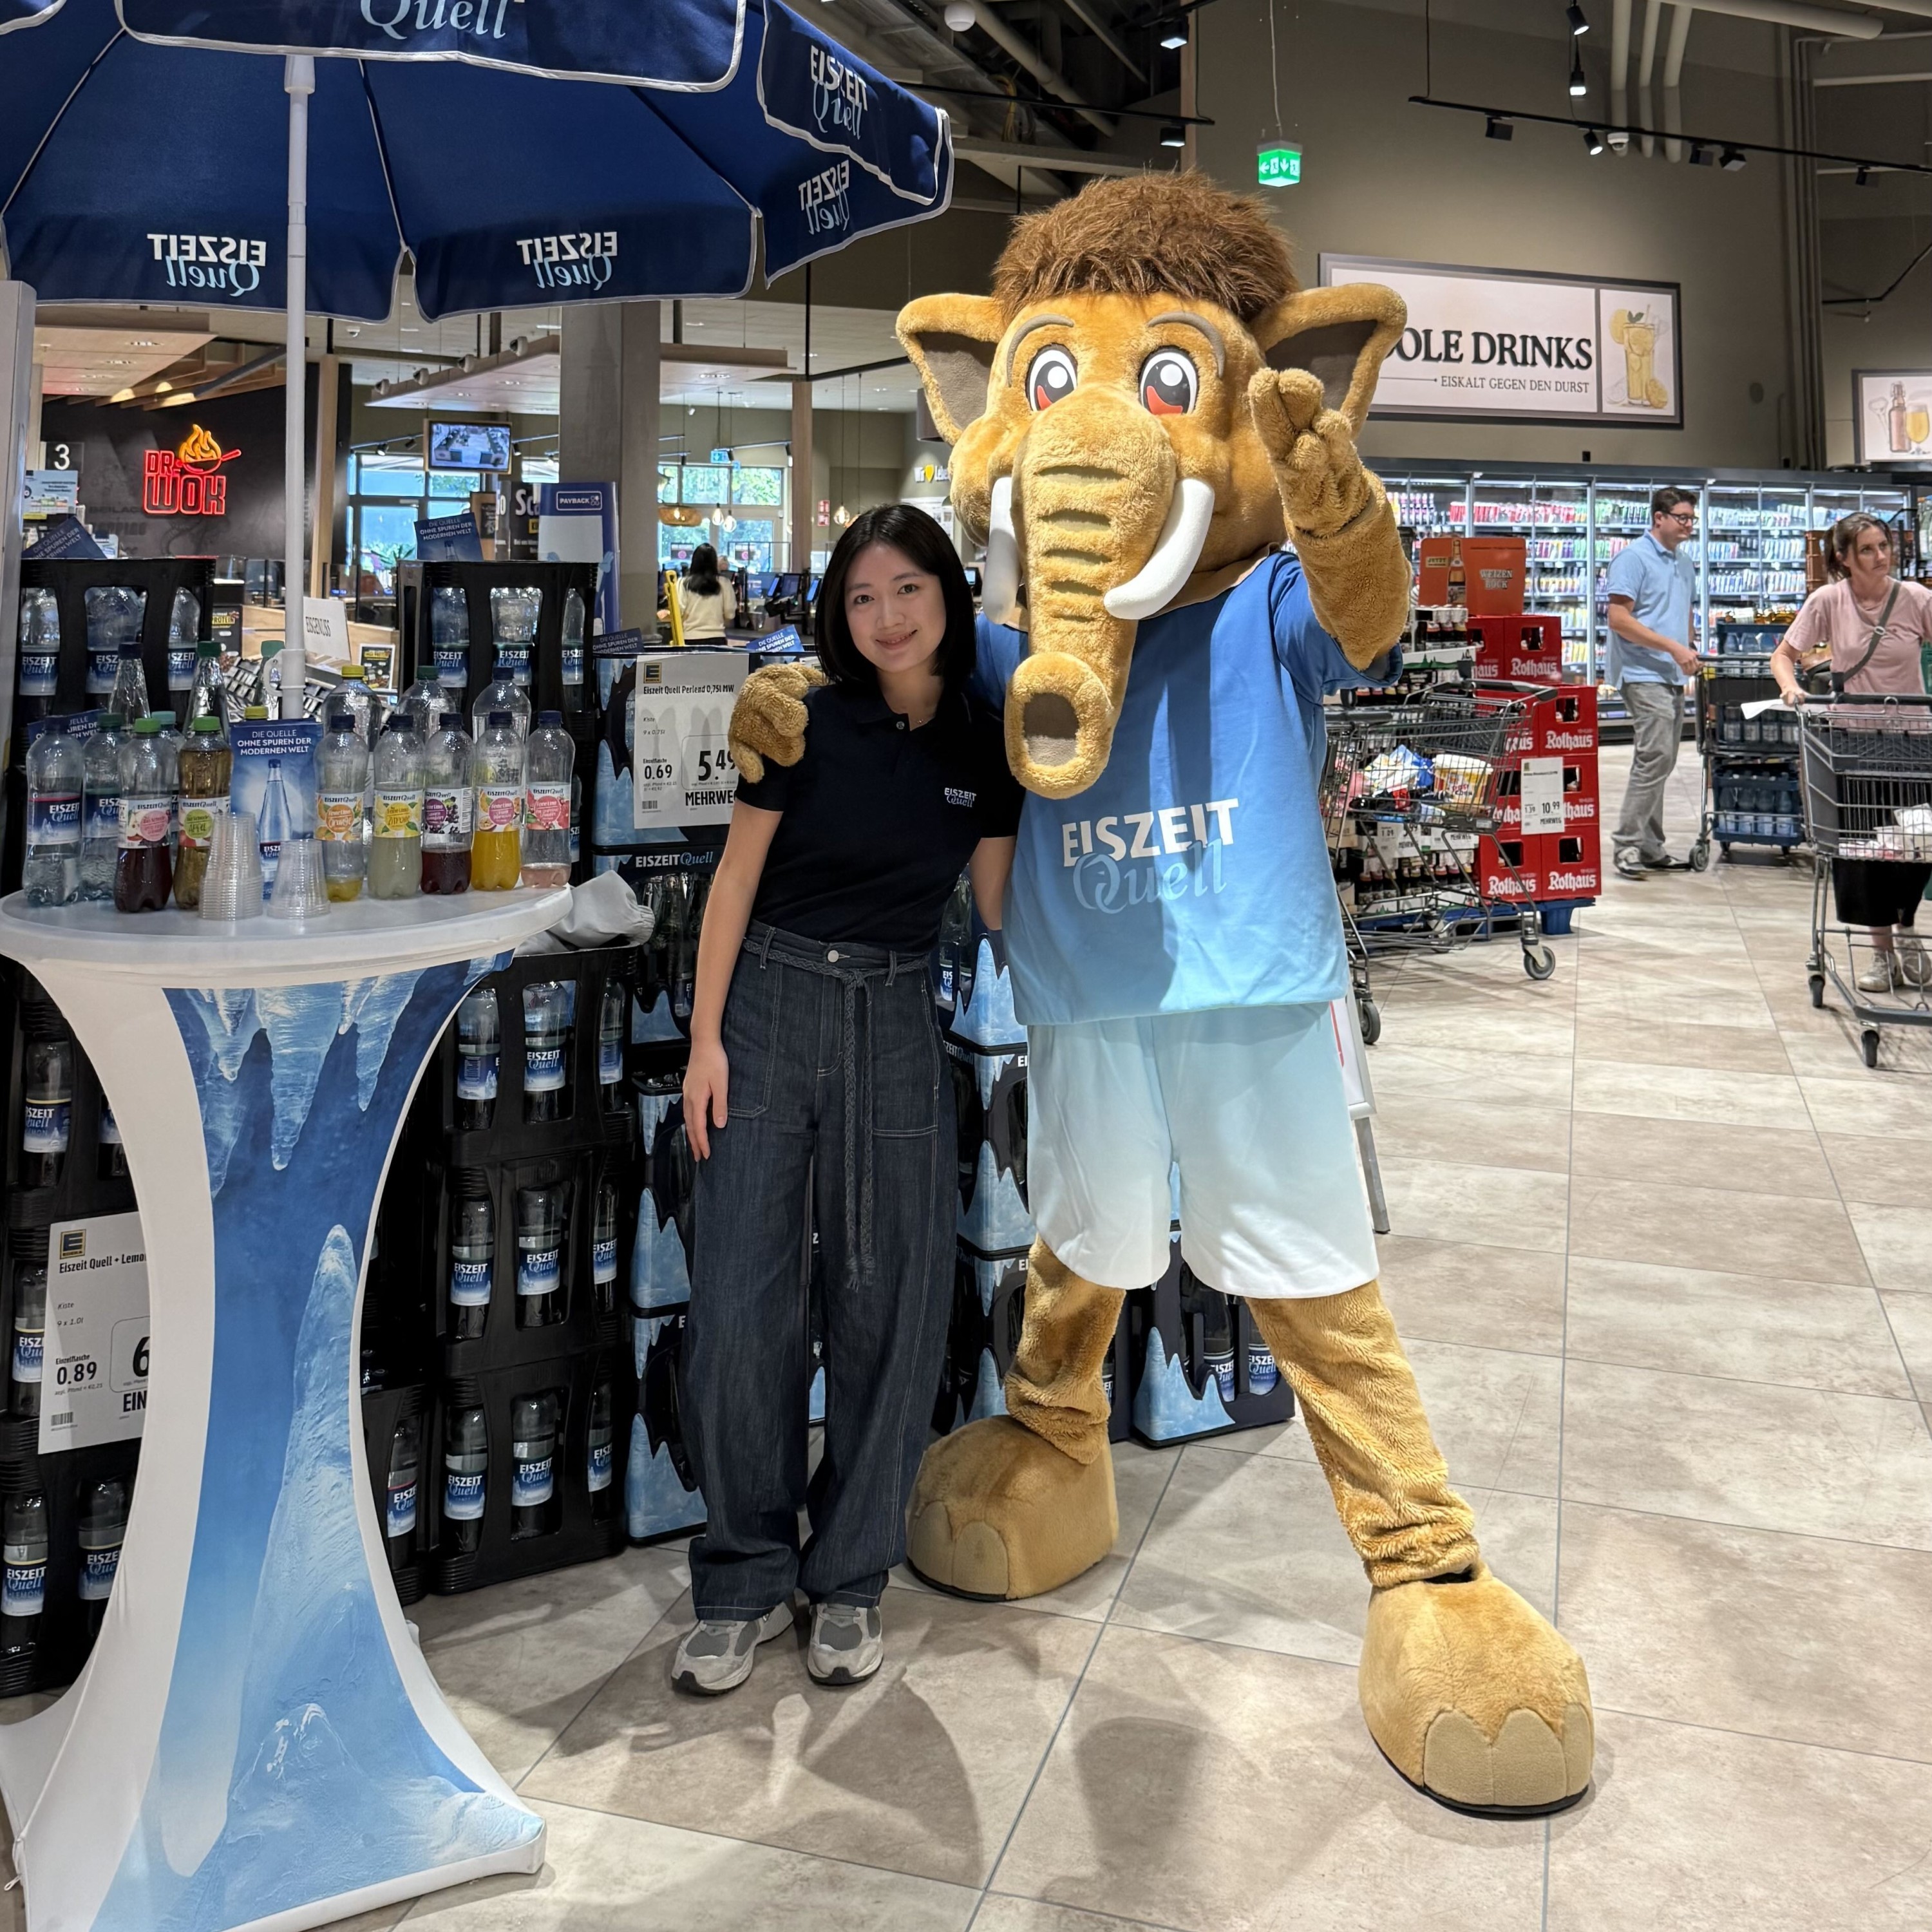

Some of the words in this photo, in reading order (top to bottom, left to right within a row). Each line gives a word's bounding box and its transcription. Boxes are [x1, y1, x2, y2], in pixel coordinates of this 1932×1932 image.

[361, 0, 508, 39] Quell
[1386, 327, 1464, 363] OLE
[1472, 332, 1593, 370] DRINKS
[1441, 376, 1486, 389] EISKALT
[1489, 378, 1526, 390] GEGEN
[1530, 380, 1551, 392] DEN
[1555, 381, 1589, 393] DURST
[54, 444, 70, 470] 3
[144, 474, 226, 515] WOK
[457, 527, 471, 536] WELT
[1480, 569, 1513, 579] WEIZEN
[1485, 580, 1508, 589] BOCK
[96, 654, 119, 664] EISZ
[168, 652, 196, 662] ISZEIT
[500, 650, 530, 659] EISZEIT
[562, 649, 583, 658] EISZE
[22, 656, 57, 666] EISZEIT
[643, 685, 663, 695] Eiszeit
[665, 685, 680, 695] Quell
[681, 684, 705, 694] Perlend
[723, 683, 735, 693] MW
[266, 729, 297, 739] QUELLE
[1546, 730, 1593, 750] Rothaus
[262, 738, 294, 747] SPUREN
[240, 746, 287, 755] MODERNEN
[644, 764, 672, 780] 0.69
[944, 787, 976, 802] EISZEIT
[947, 793, 972, 808] Quell
[99, 797, 120, 808] EISZ
[1564, 802, 1594, 820] thaus
[1062, 798, 1240, 868] EISZEIT
[635, 854, 680, 868] EISZEIT
[680, 851, 714, 866] Quell
[1072, 838, 1227, 914] Quell
[1548, 871, 1597, 892] Rothaus
[527, 1049, 561, 1061] EISZEIT
[528, 1057, 558, 1070] Quell
[26, 1106, 55, 1119] SZEIT
[593, 1238, 617, 1252] EISZE
[527, 1249, 559, 1264] EISZEIT
[59, 1260, 88, 1274] Eiszeit
[90, 1256, 112, 1270] Quell
[454, 1262, 488, 1274] EISZEIT
[529, 1258, 557, 1273] Quell
[57, 1302, 75, 1311] Kiste
[19, 1336, 43, 1348] EISZ
[55, 1354, 90, 1365] Einzelflasche
[1248, 1354, 1274, 1365] EISZE
[57, 1361, 97, 1385] 0.89
[123, 1390, 147, 1413] EIN
[594, 1446, 611, 1460] EISZ
[520, 1457, 553, 1474] EISZEIT
[448, 1474, 482, 1487] EISZEIT
[522, 1468, 551, 1483] Quell
[394, 1485, 417, 1504] EISZE
[87, 1550, 118, 1565] EISZE
[7, 1566, 47, 1580] EISZEIT
[89, 1562, 115, 1576] Que
[8, 1577, 43, 1592] Quell
